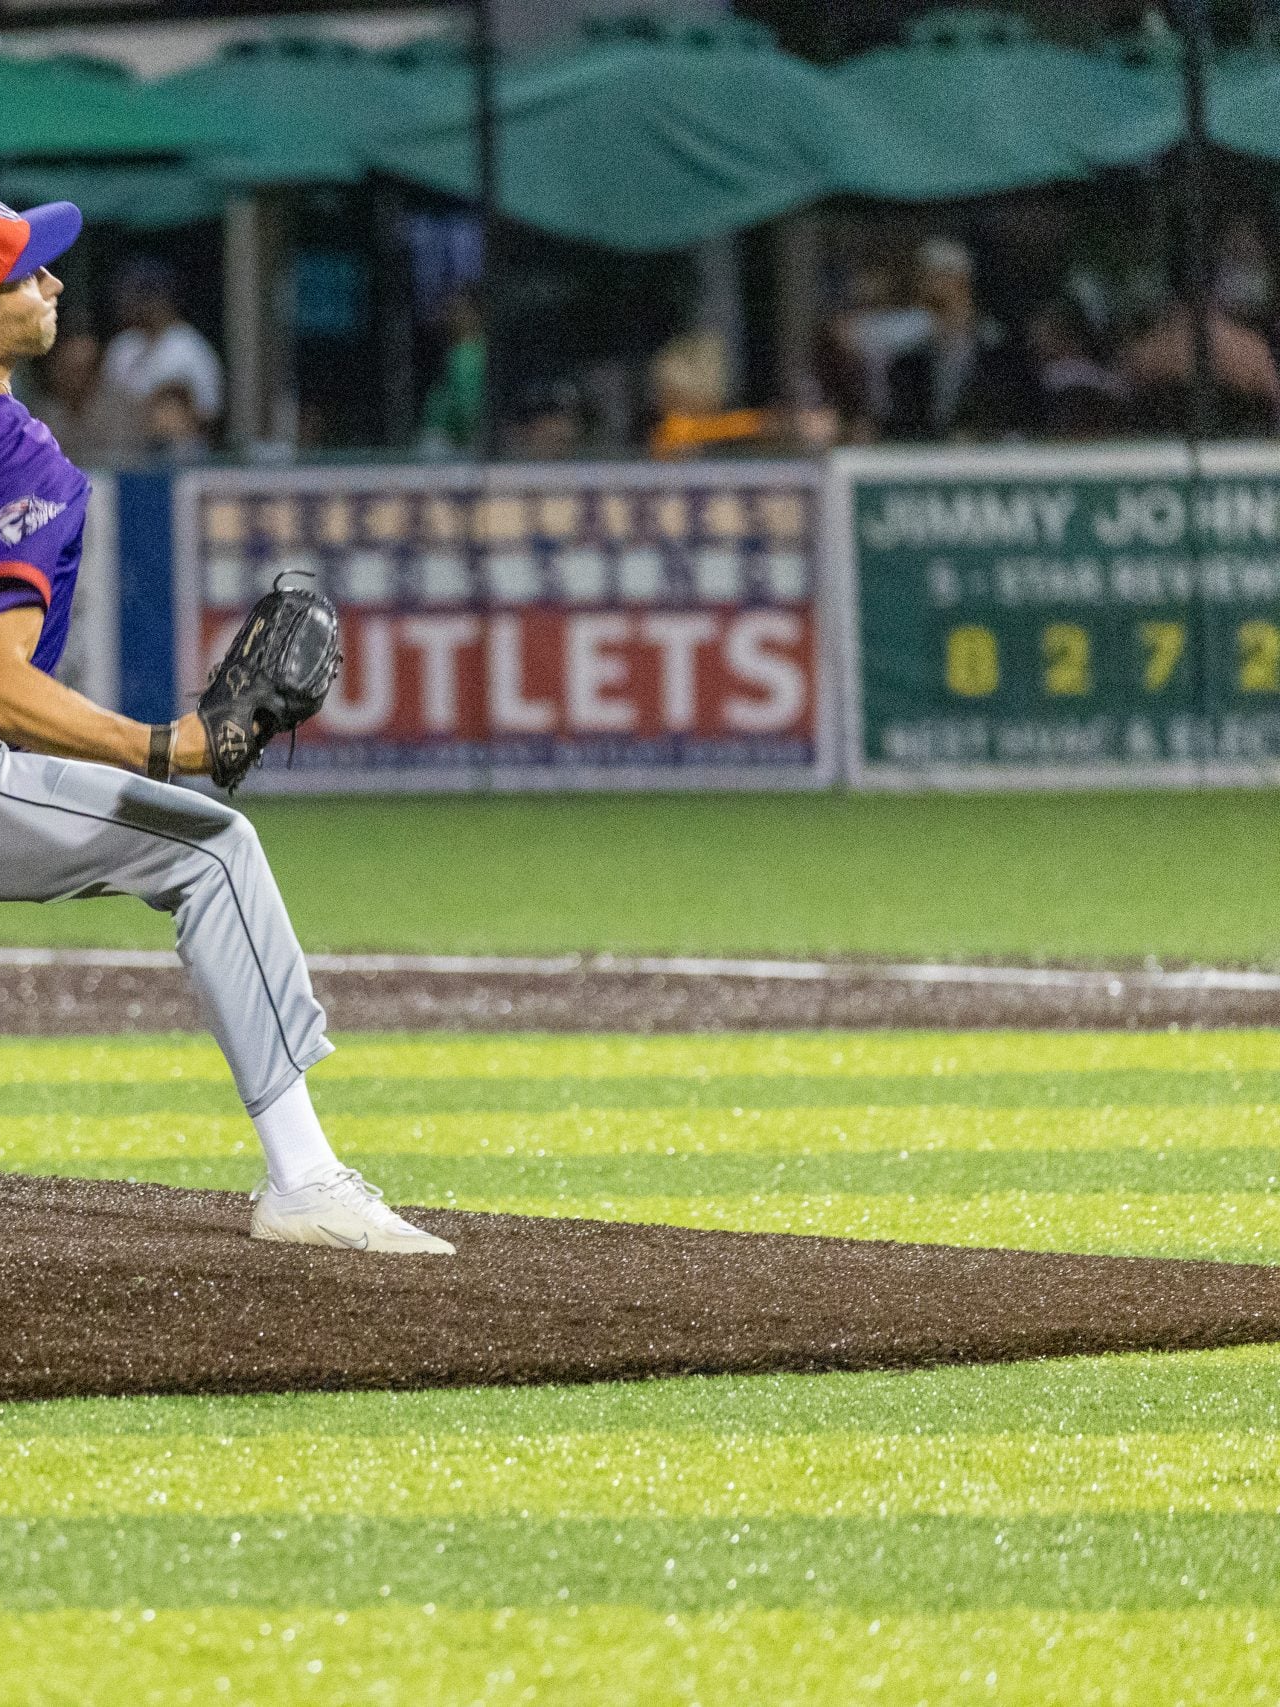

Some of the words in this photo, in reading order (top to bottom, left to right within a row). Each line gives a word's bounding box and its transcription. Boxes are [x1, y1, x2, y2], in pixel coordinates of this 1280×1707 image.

[865, 488, 1076, 549] JIMMY
[201, 608, 808, 734] UTLETS
[1042, 622, 1091, 695] 2
[1139, 620, 1186, 693] 7
[1236, 619, 1280, 693] 2
